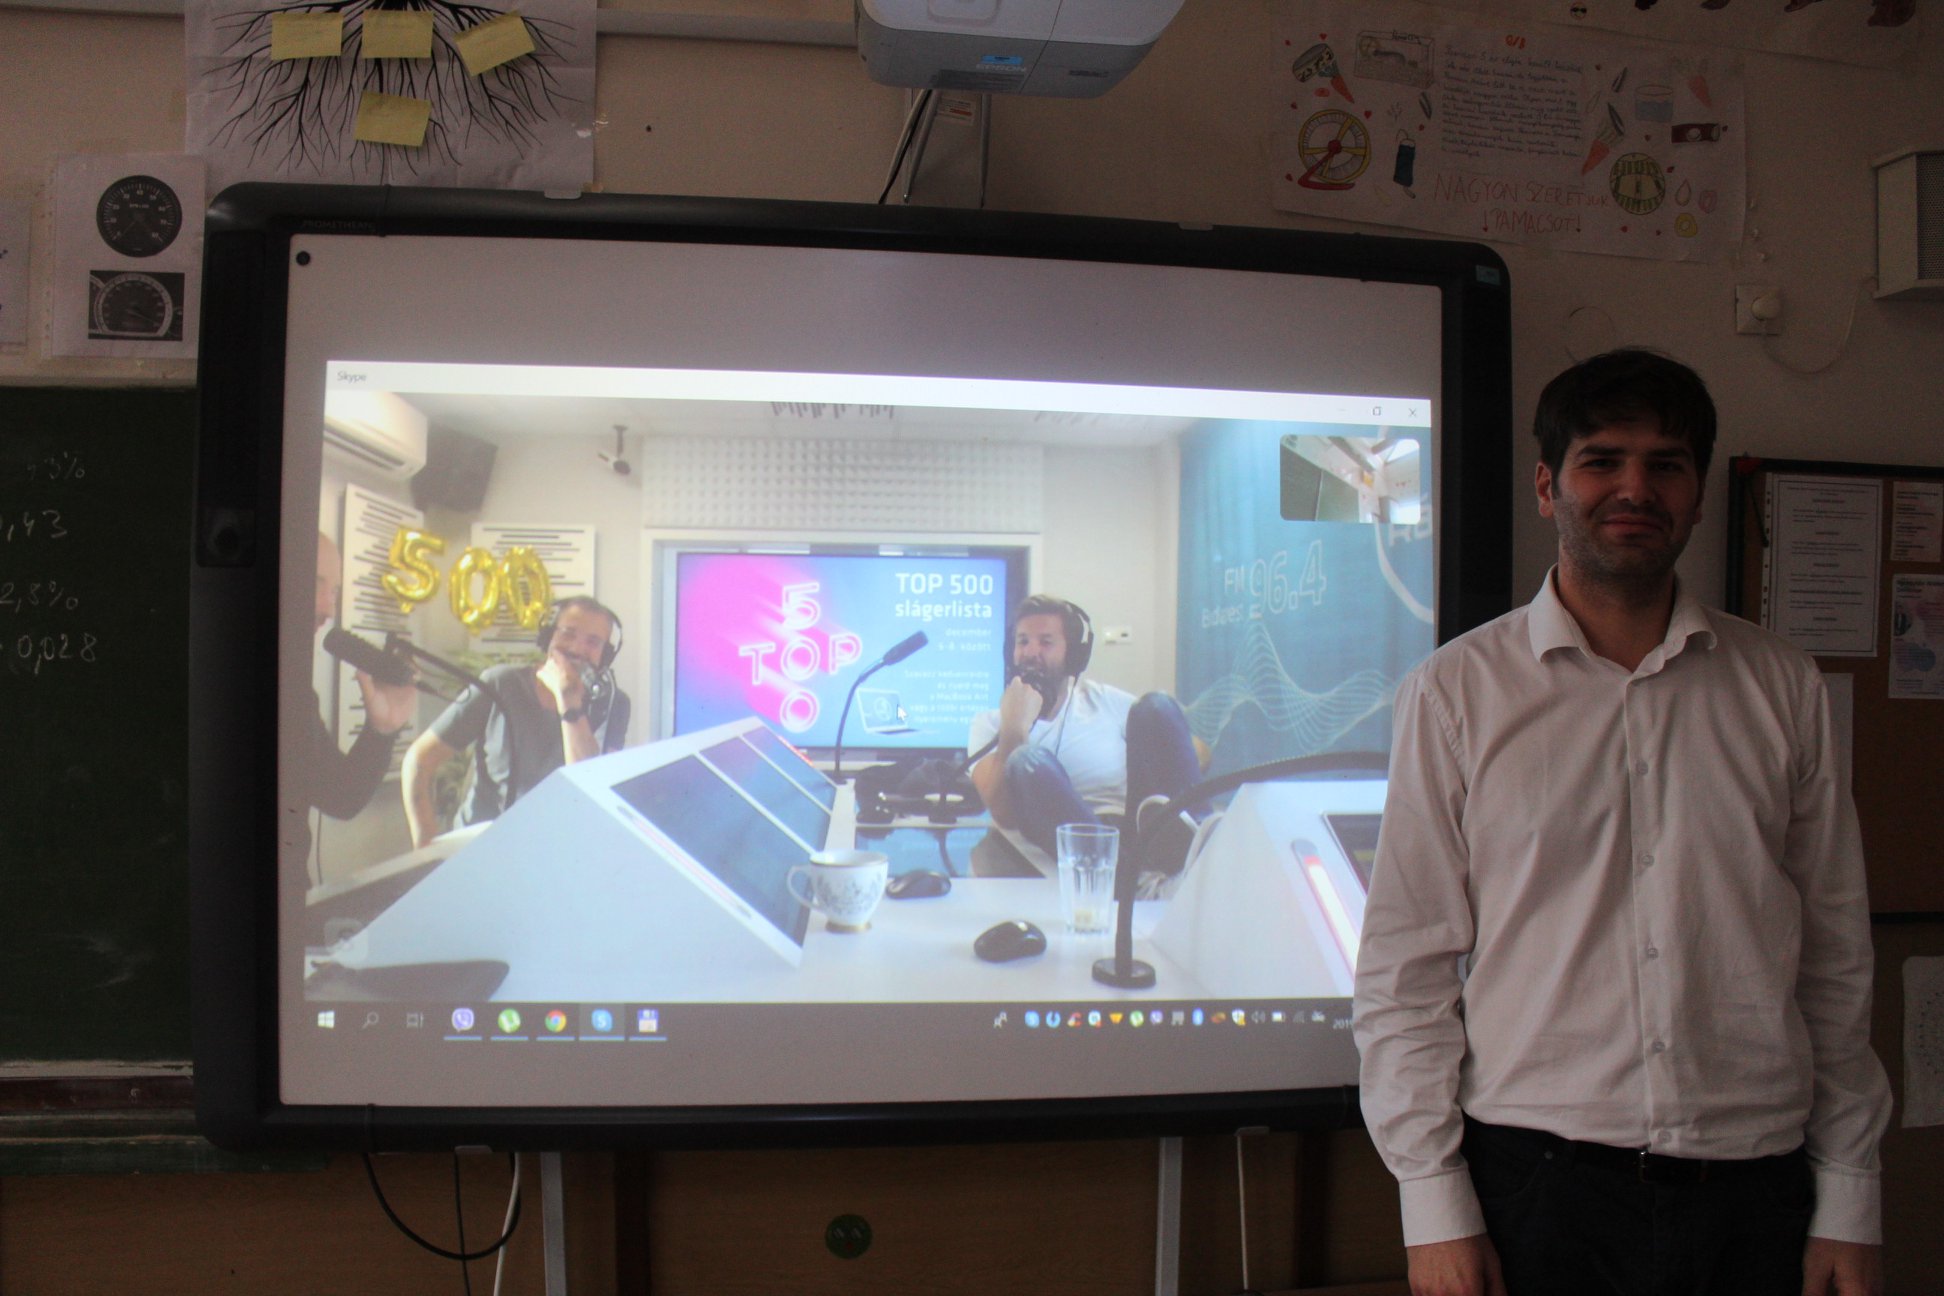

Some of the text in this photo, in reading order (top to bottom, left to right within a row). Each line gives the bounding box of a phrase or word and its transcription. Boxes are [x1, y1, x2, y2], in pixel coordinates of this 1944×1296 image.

[337, 370, 367, 383] Skype
[895, 573, 994, 596] TOP 500
[895, 599, 993, 622] slágerlista
